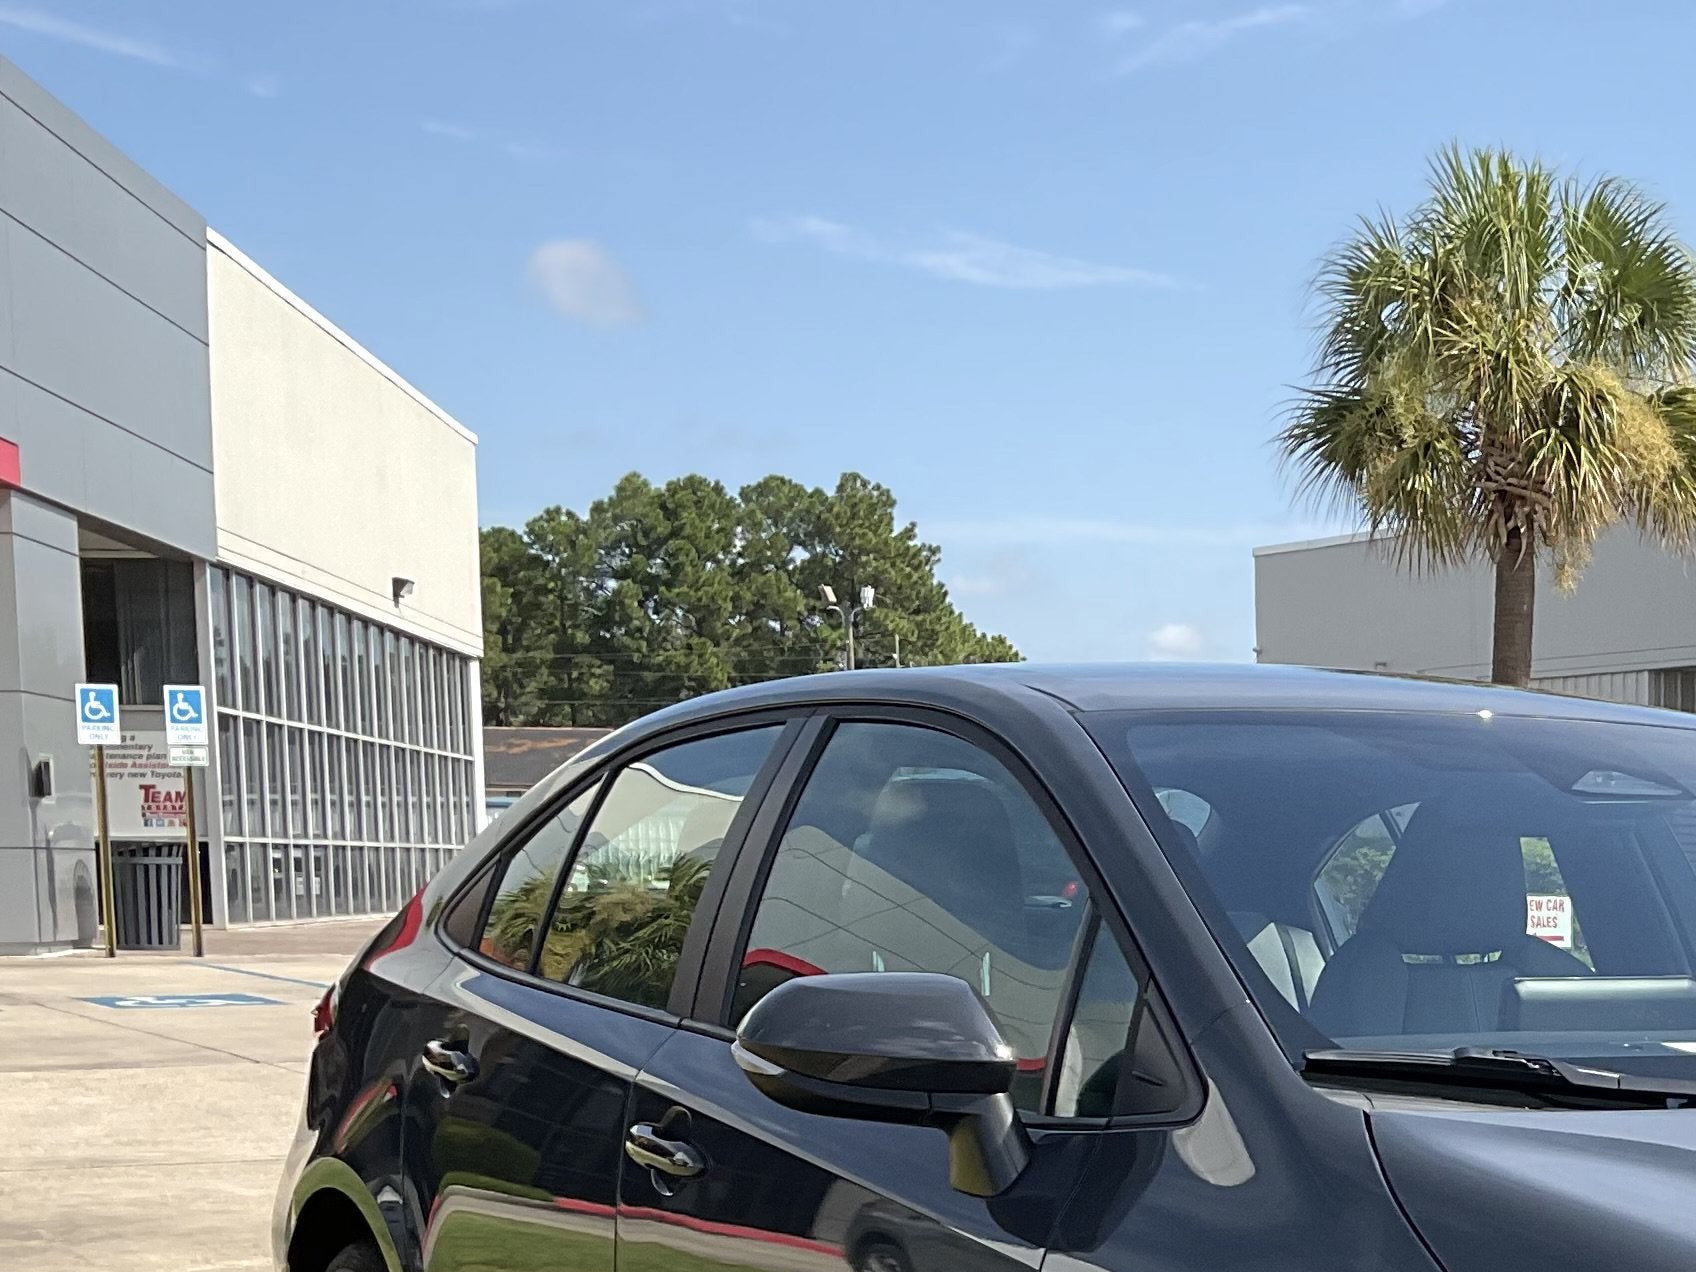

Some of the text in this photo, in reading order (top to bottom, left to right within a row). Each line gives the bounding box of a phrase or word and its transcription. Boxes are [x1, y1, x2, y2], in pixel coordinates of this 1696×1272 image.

[1529, 898, 1565, 913] EW CAR
[1530, 914, 1558, 929] SALES
